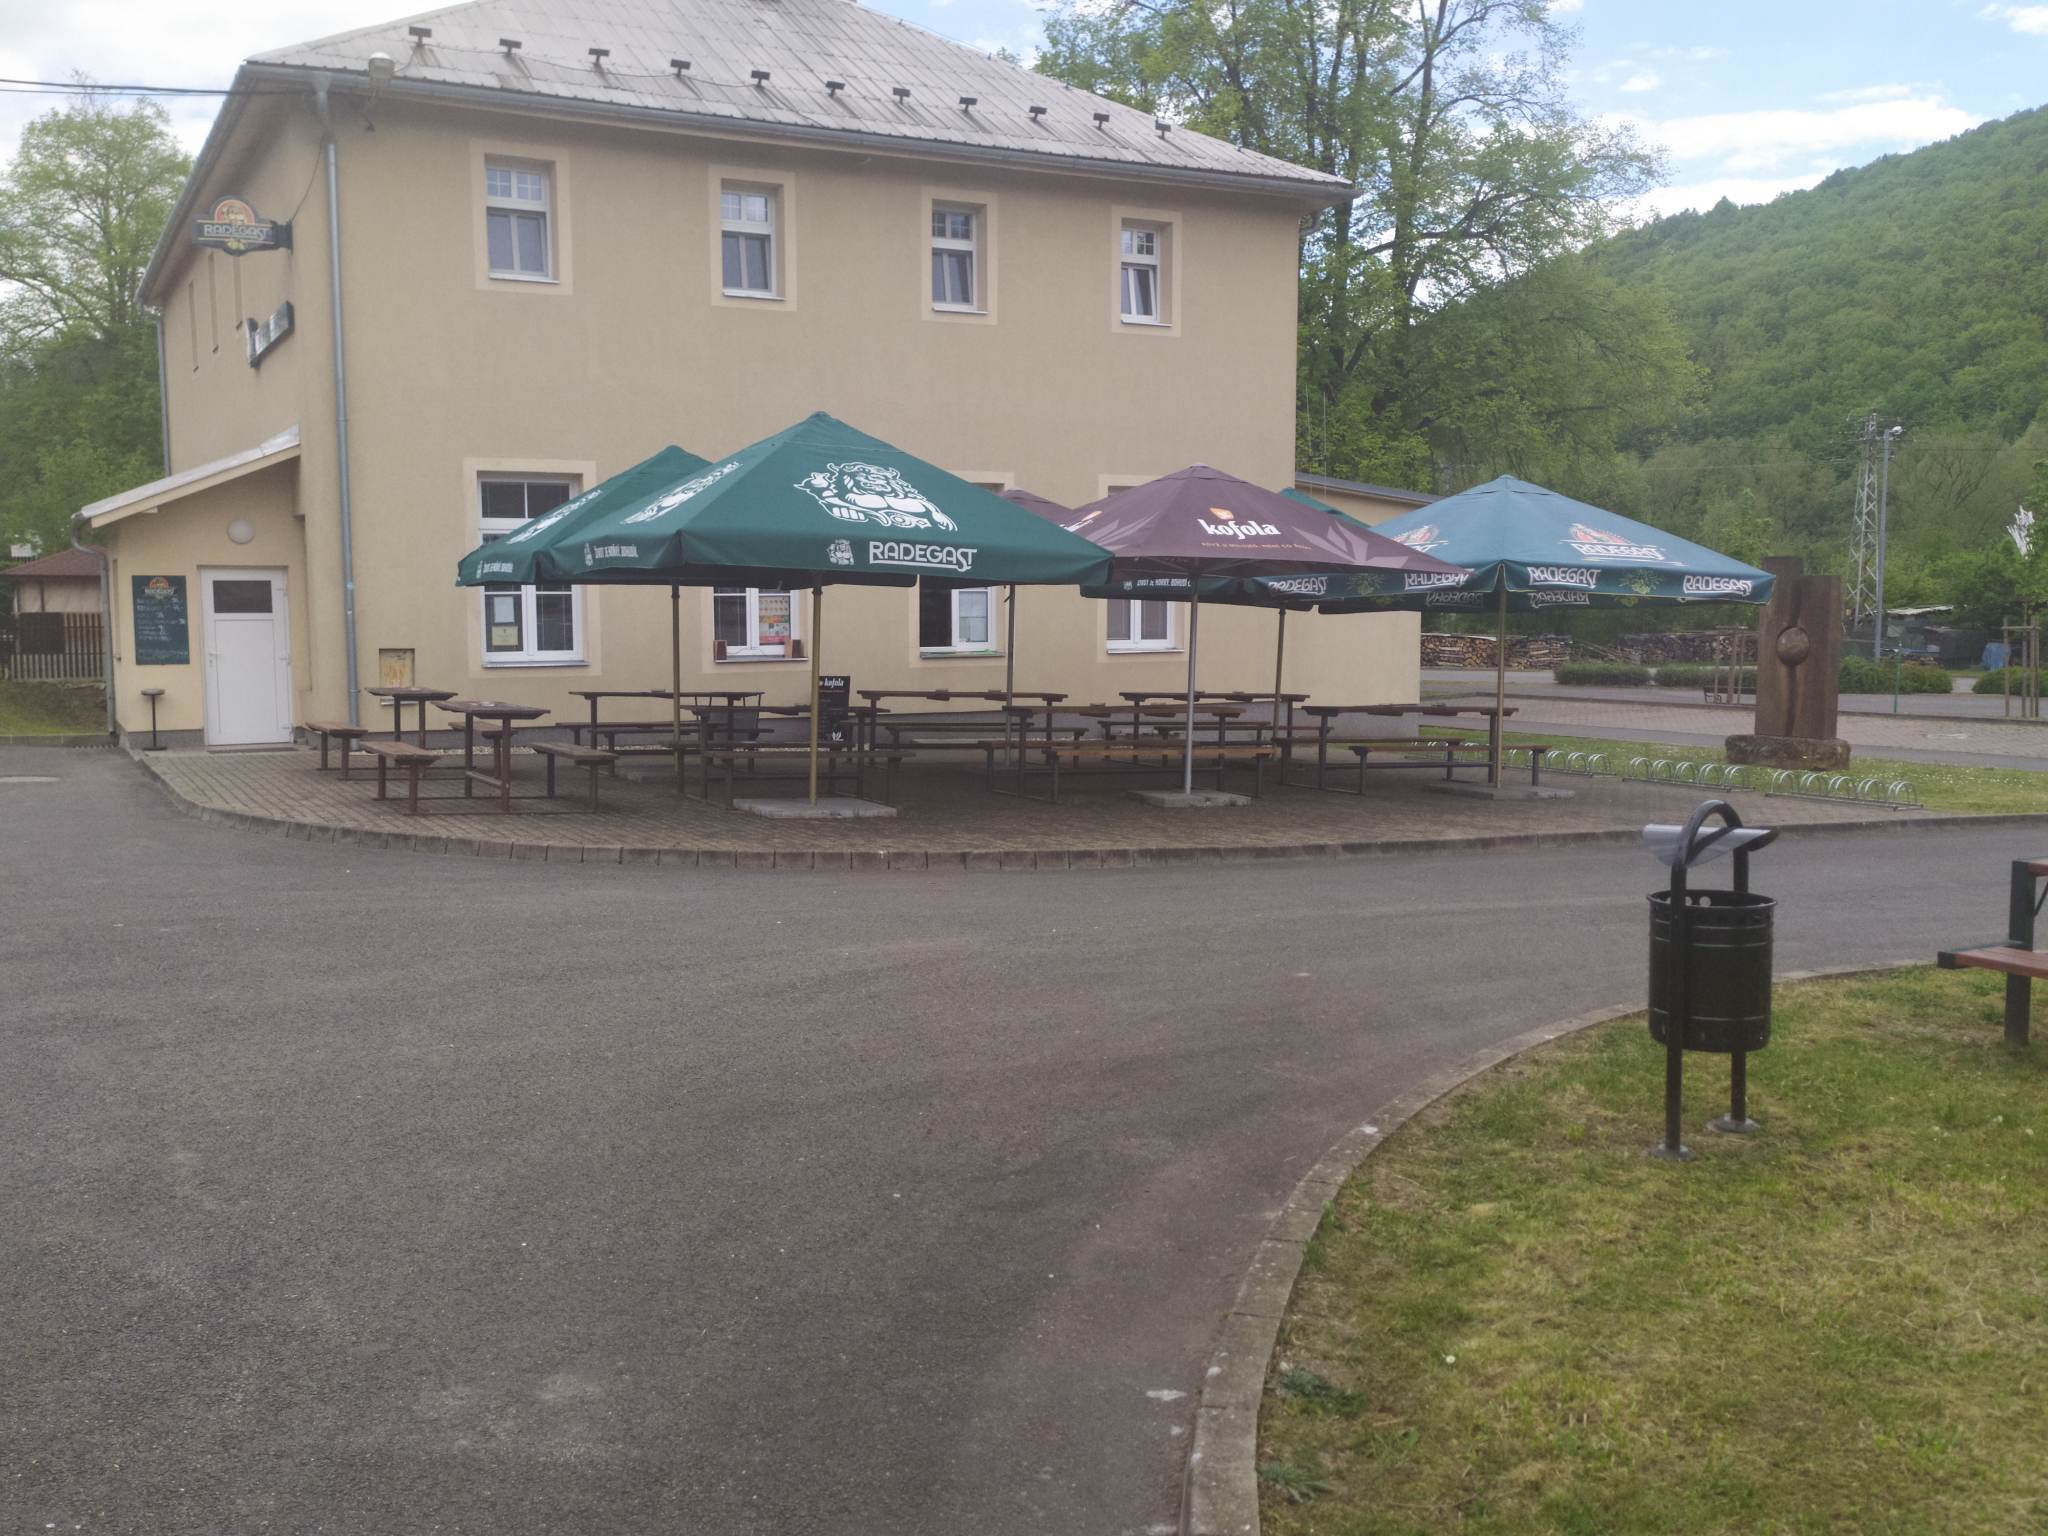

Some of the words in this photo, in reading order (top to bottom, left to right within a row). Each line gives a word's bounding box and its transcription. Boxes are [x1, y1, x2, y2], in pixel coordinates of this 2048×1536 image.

[203, 223, 271, 241] RADEGAST
[1197, 518, 1281, 540] kofola
[869, 541, 978, 573] RADEGAST
[1527, 566, 1602, 589] RADEGAST
[1683, 575, 1753, 597] RADEGAST
